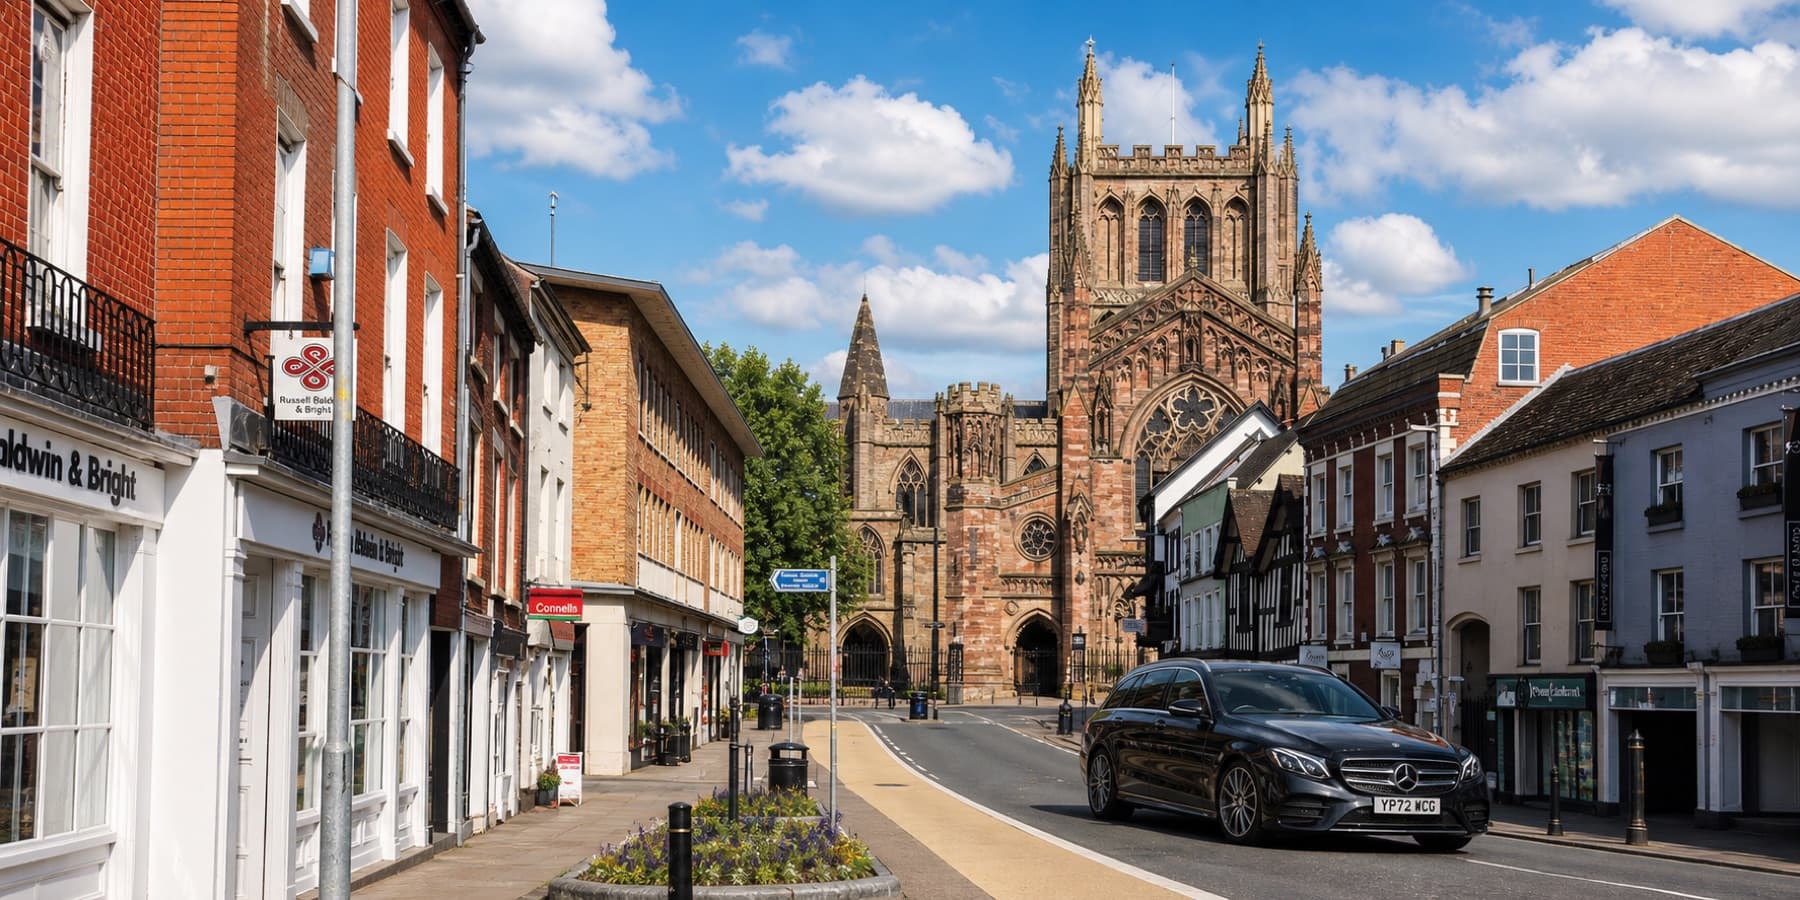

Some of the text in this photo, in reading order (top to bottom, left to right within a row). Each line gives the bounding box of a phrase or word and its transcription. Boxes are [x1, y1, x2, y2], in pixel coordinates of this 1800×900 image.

[313, 396, 334, 404] Bald
[296, 405, 332, 415] & Bright
[68, 449, 83, 487] &
[88, 455, 137, 506] Bright
[536, 602, 578, 613] Connells
[1381, 799, 1436, 812] YP72 WCG
